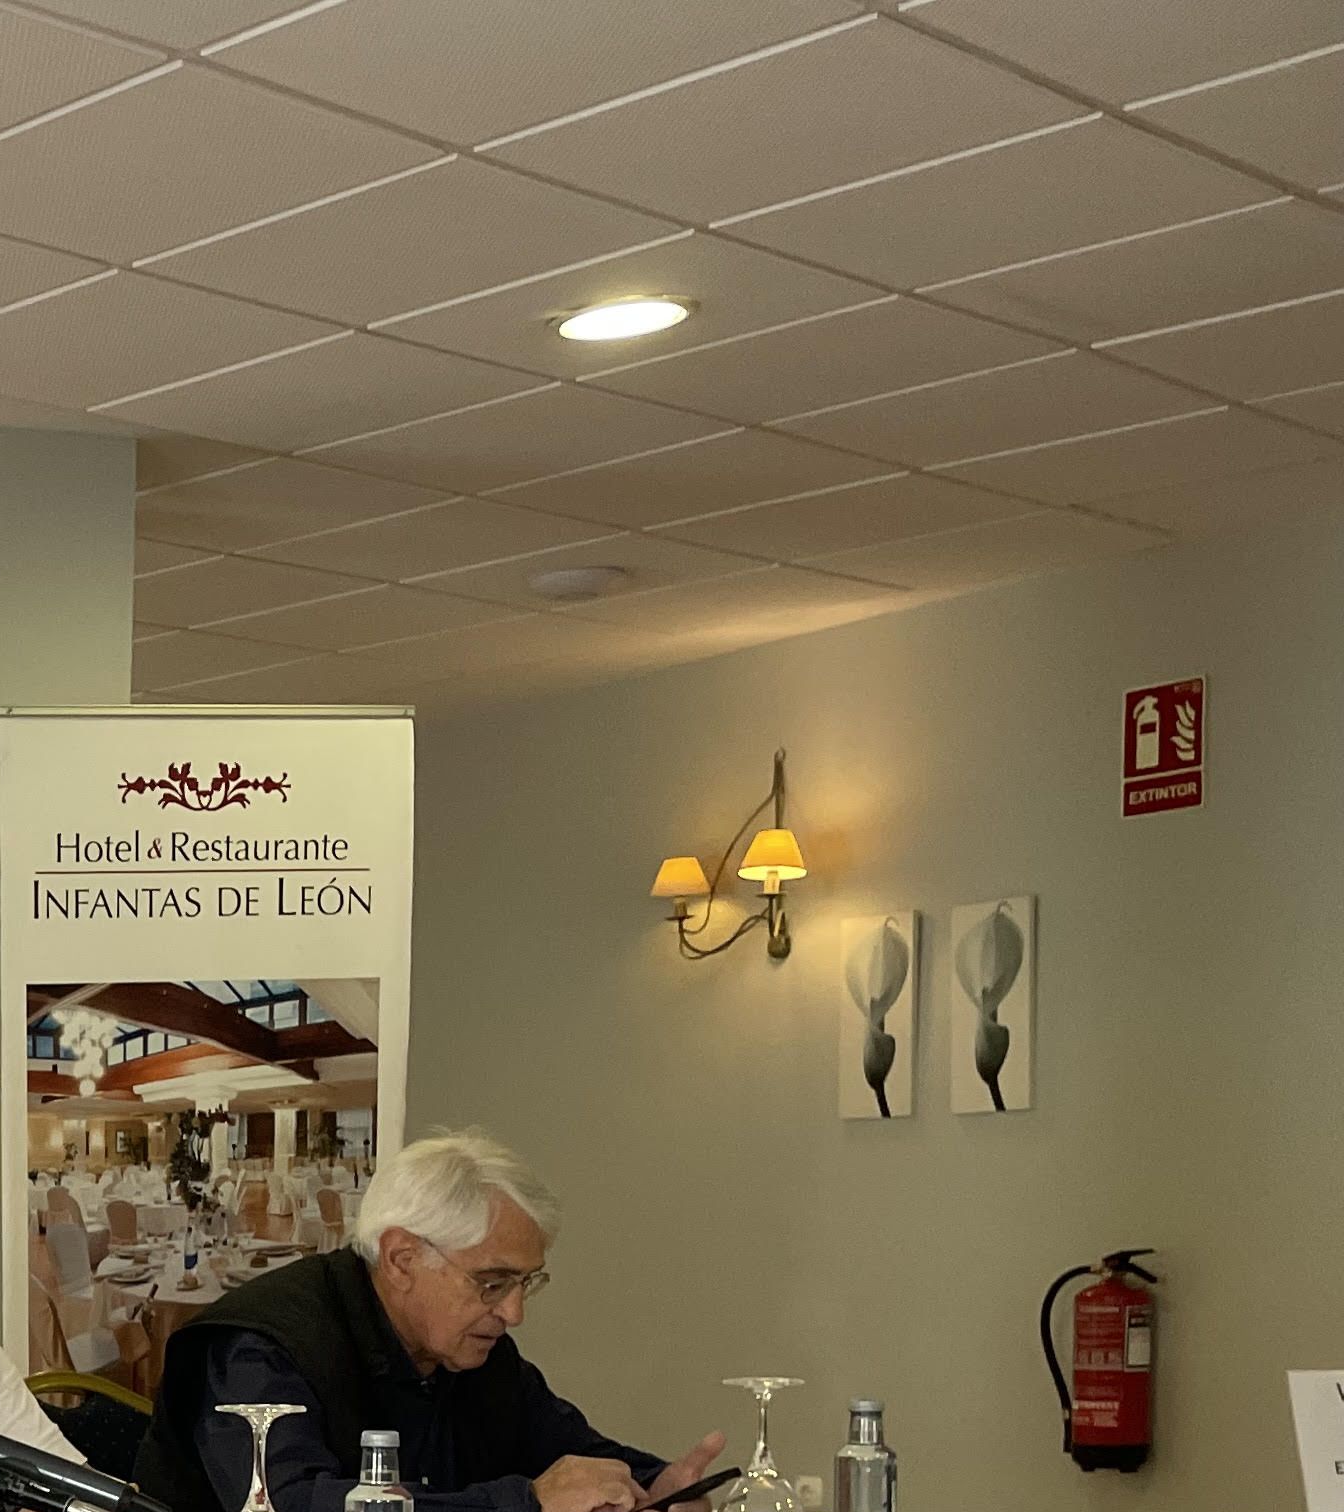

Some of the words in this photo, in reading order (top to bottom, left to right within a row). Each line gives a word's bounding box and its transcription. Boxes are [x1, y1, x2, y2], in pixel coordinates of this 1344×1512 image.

[1128, 782, 1198, 806] EXTINTOR
[55, 829, 141, 864] Hotel
[146, 836, 163, 861] &
[170, 831, 350, 863] Restaurante
[32, 879, 202, 920] INFANTAS
[216, 885, 261, 918] DE
[276, 876, 373, 917] LEÓN
